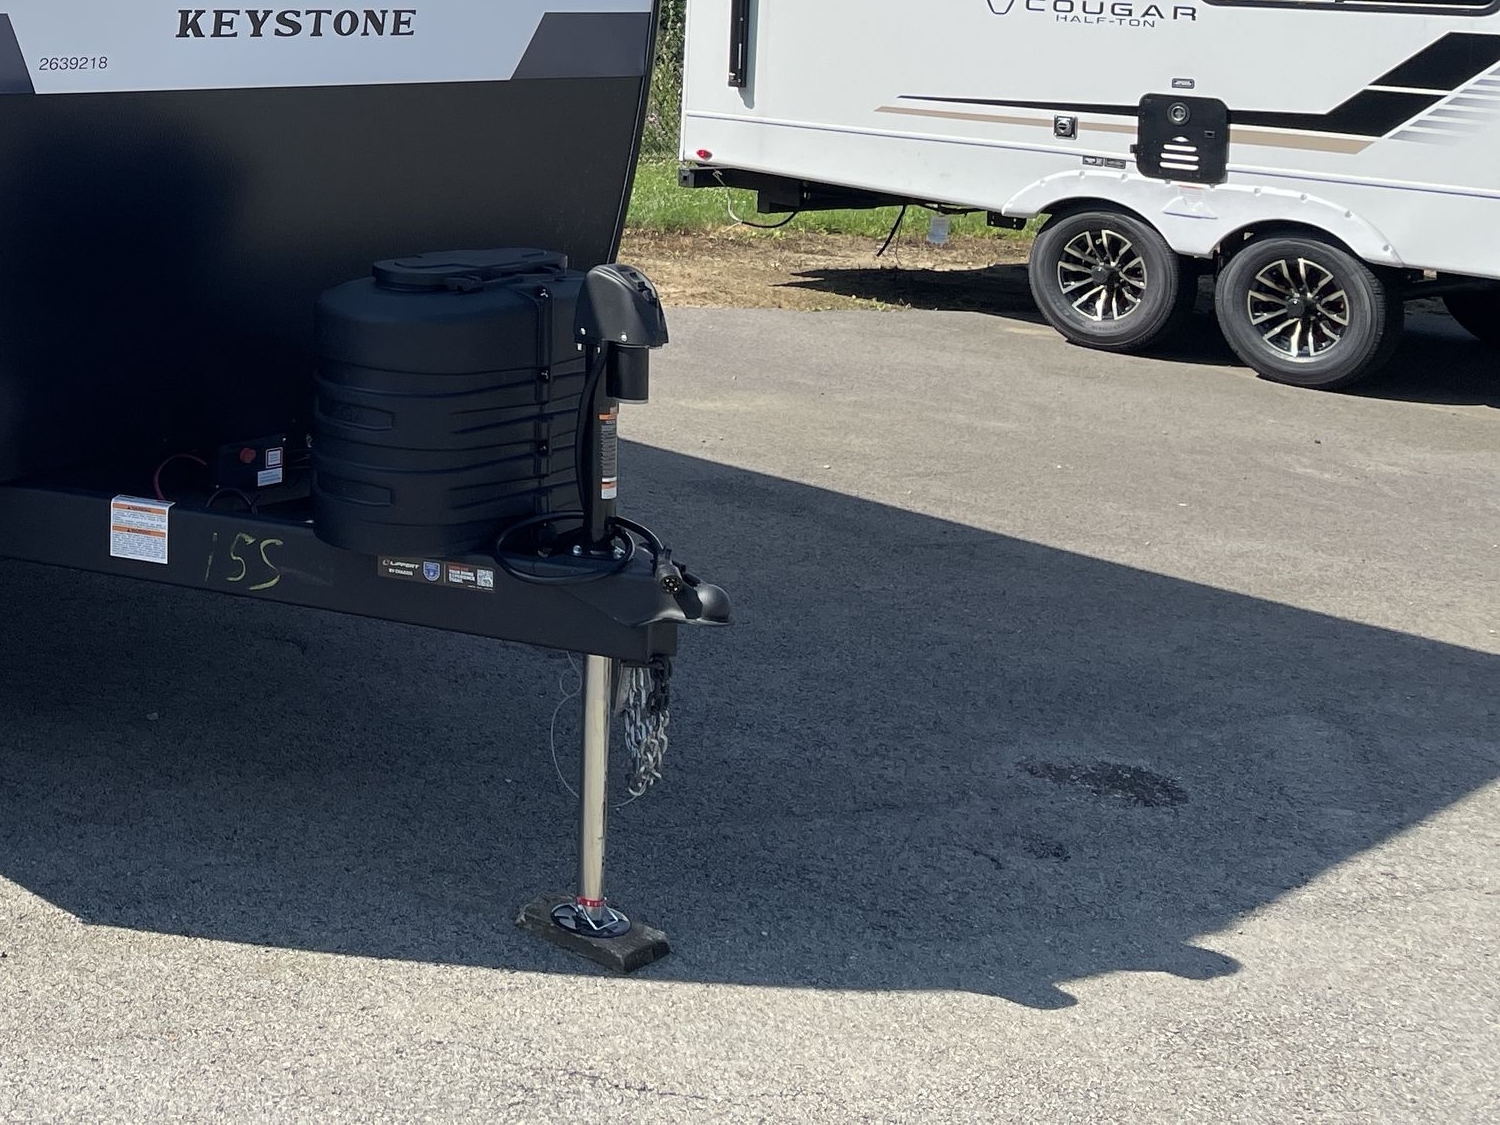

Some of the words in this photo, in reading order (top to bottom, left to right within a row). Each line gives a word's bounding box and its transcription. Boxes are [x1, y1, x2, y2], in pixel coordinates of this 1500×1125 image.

[175, 9, 417, 38] KEYSTONE
[1056, 14, 1155, 28] HALF-TON
[38, 56, 108, 71] 2639218
